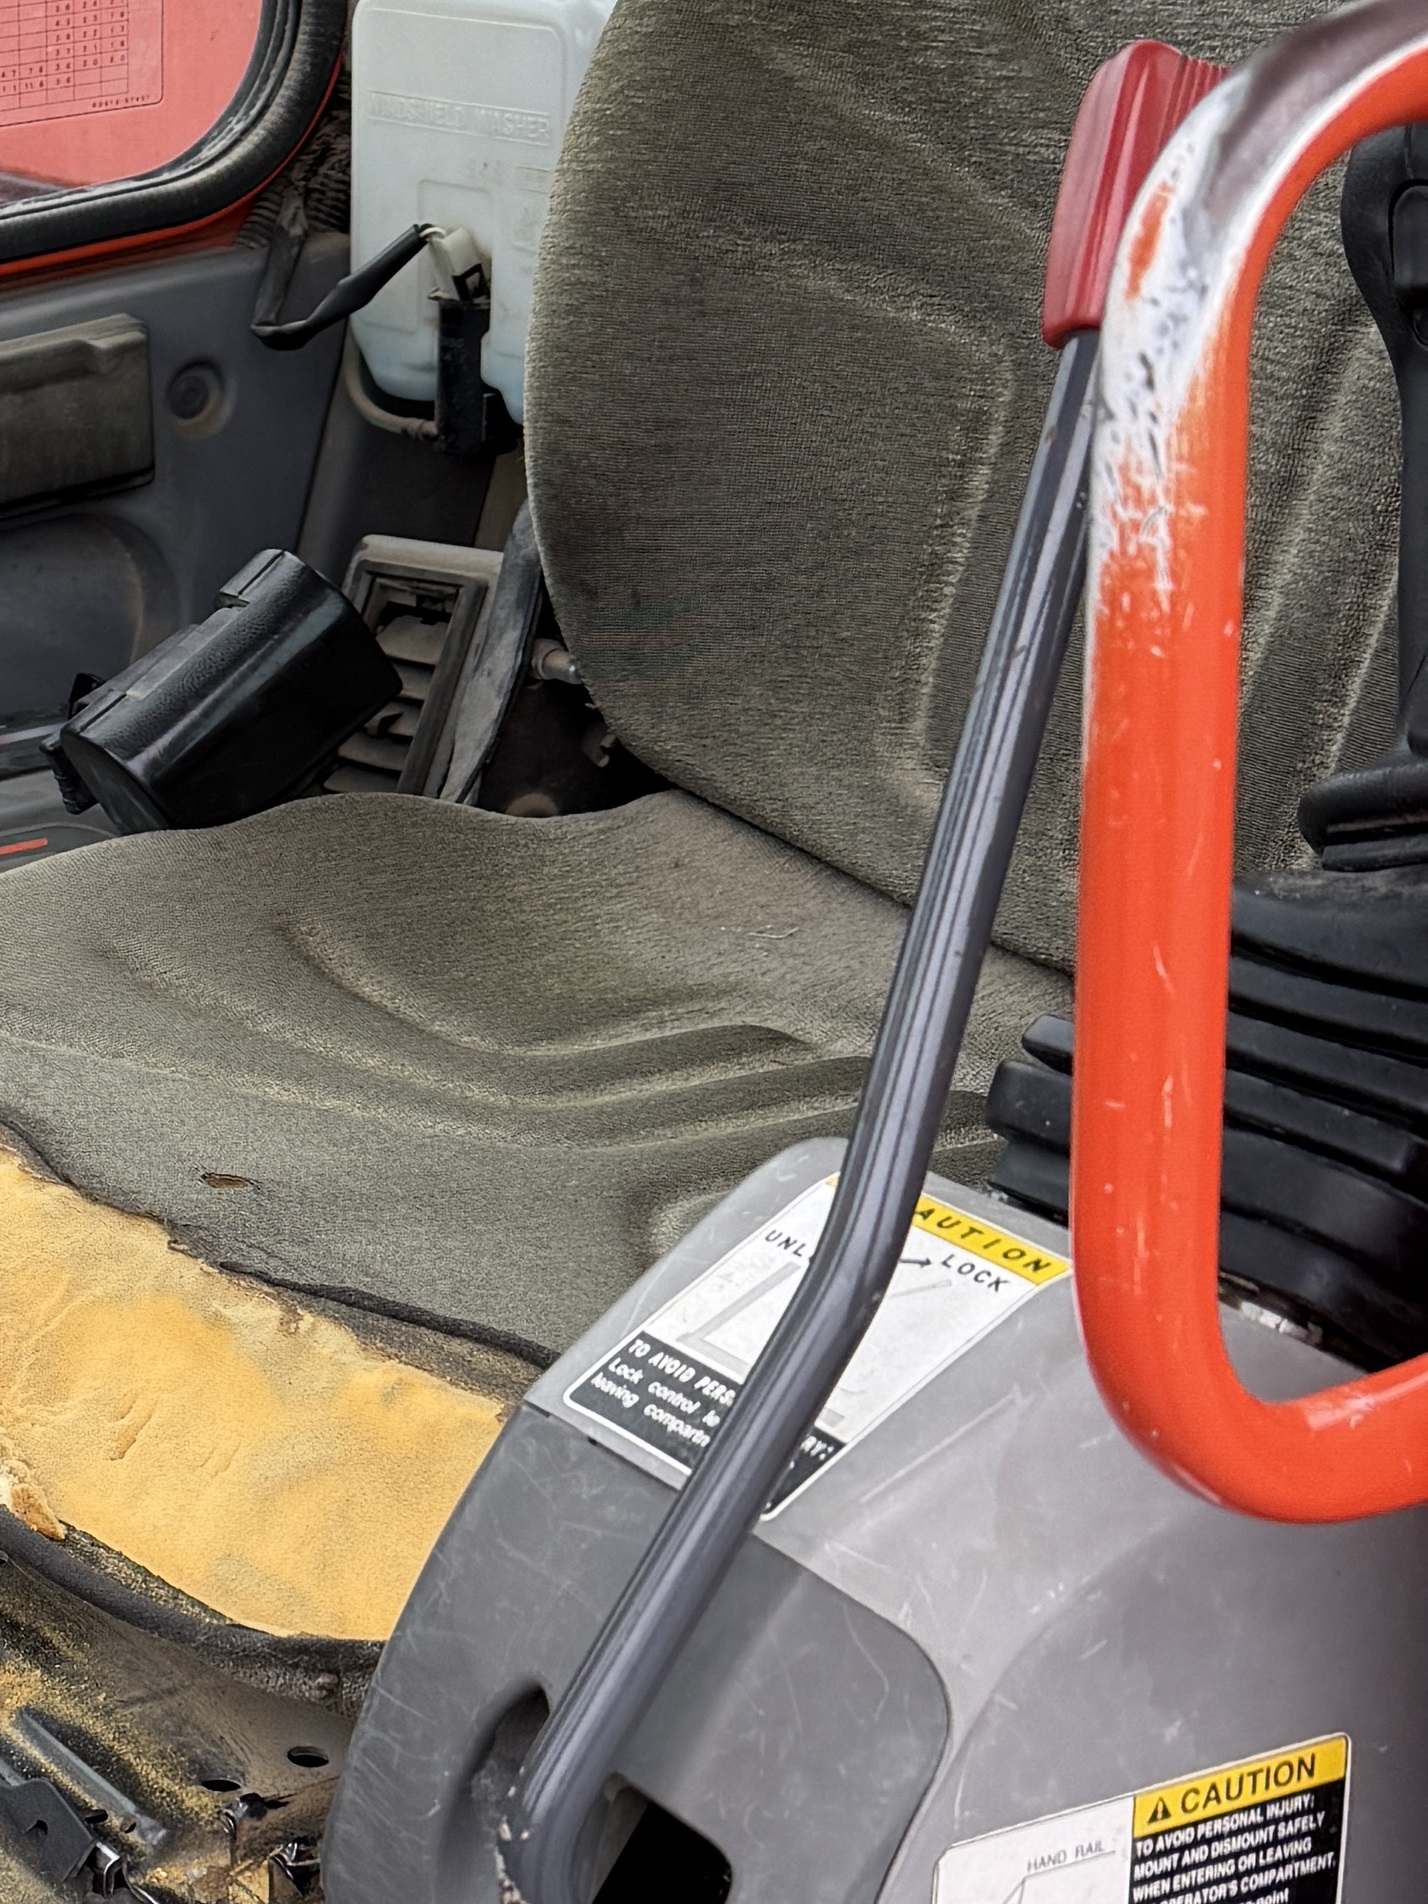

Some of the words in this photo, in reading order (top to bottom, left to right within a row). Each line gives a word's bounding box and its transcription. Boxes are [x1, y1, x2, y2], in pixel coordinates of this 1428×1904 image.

[915, 1207, 1051, 1274] AUTION
[940, 1253, 1010, 1293] LOCK
[608, 1357, 643, 1384] Lock
[648, 1382, 701, 1414] control
[628, 1339, 651, 1358] TO
[649, 1352, 696, 1383] AVOID
[1180, 1753, 1315, 1813] CAUTION
[1027, 1849, 1066, 1871] HAND
[1074, 1841, 1106, 1860] RAIL
[1133, 1852, 1179, 1880] MOUNT
[1181, 1844, 1208, 1866] AND
[1210, 1825, 1275, 1858] DISMOUNT
[1277, 1811, 1324, 1838] SAFELY
[1136, 1838, 1153, 1857] TO
[1155, 1826, 1195, 1852] AVOID
[1196, 1808, 1263, 1840] PERSONAL
[1266, 1795, 1314, 1819] INJURY:
[1132, 1877, 1170, 1903] WHEN
[1172, 1858, 1235, 1891] ENTERING
[1237, 1852, 1256, 1872] OR
[1258, 1836, 1311, 1866] LEAVING
